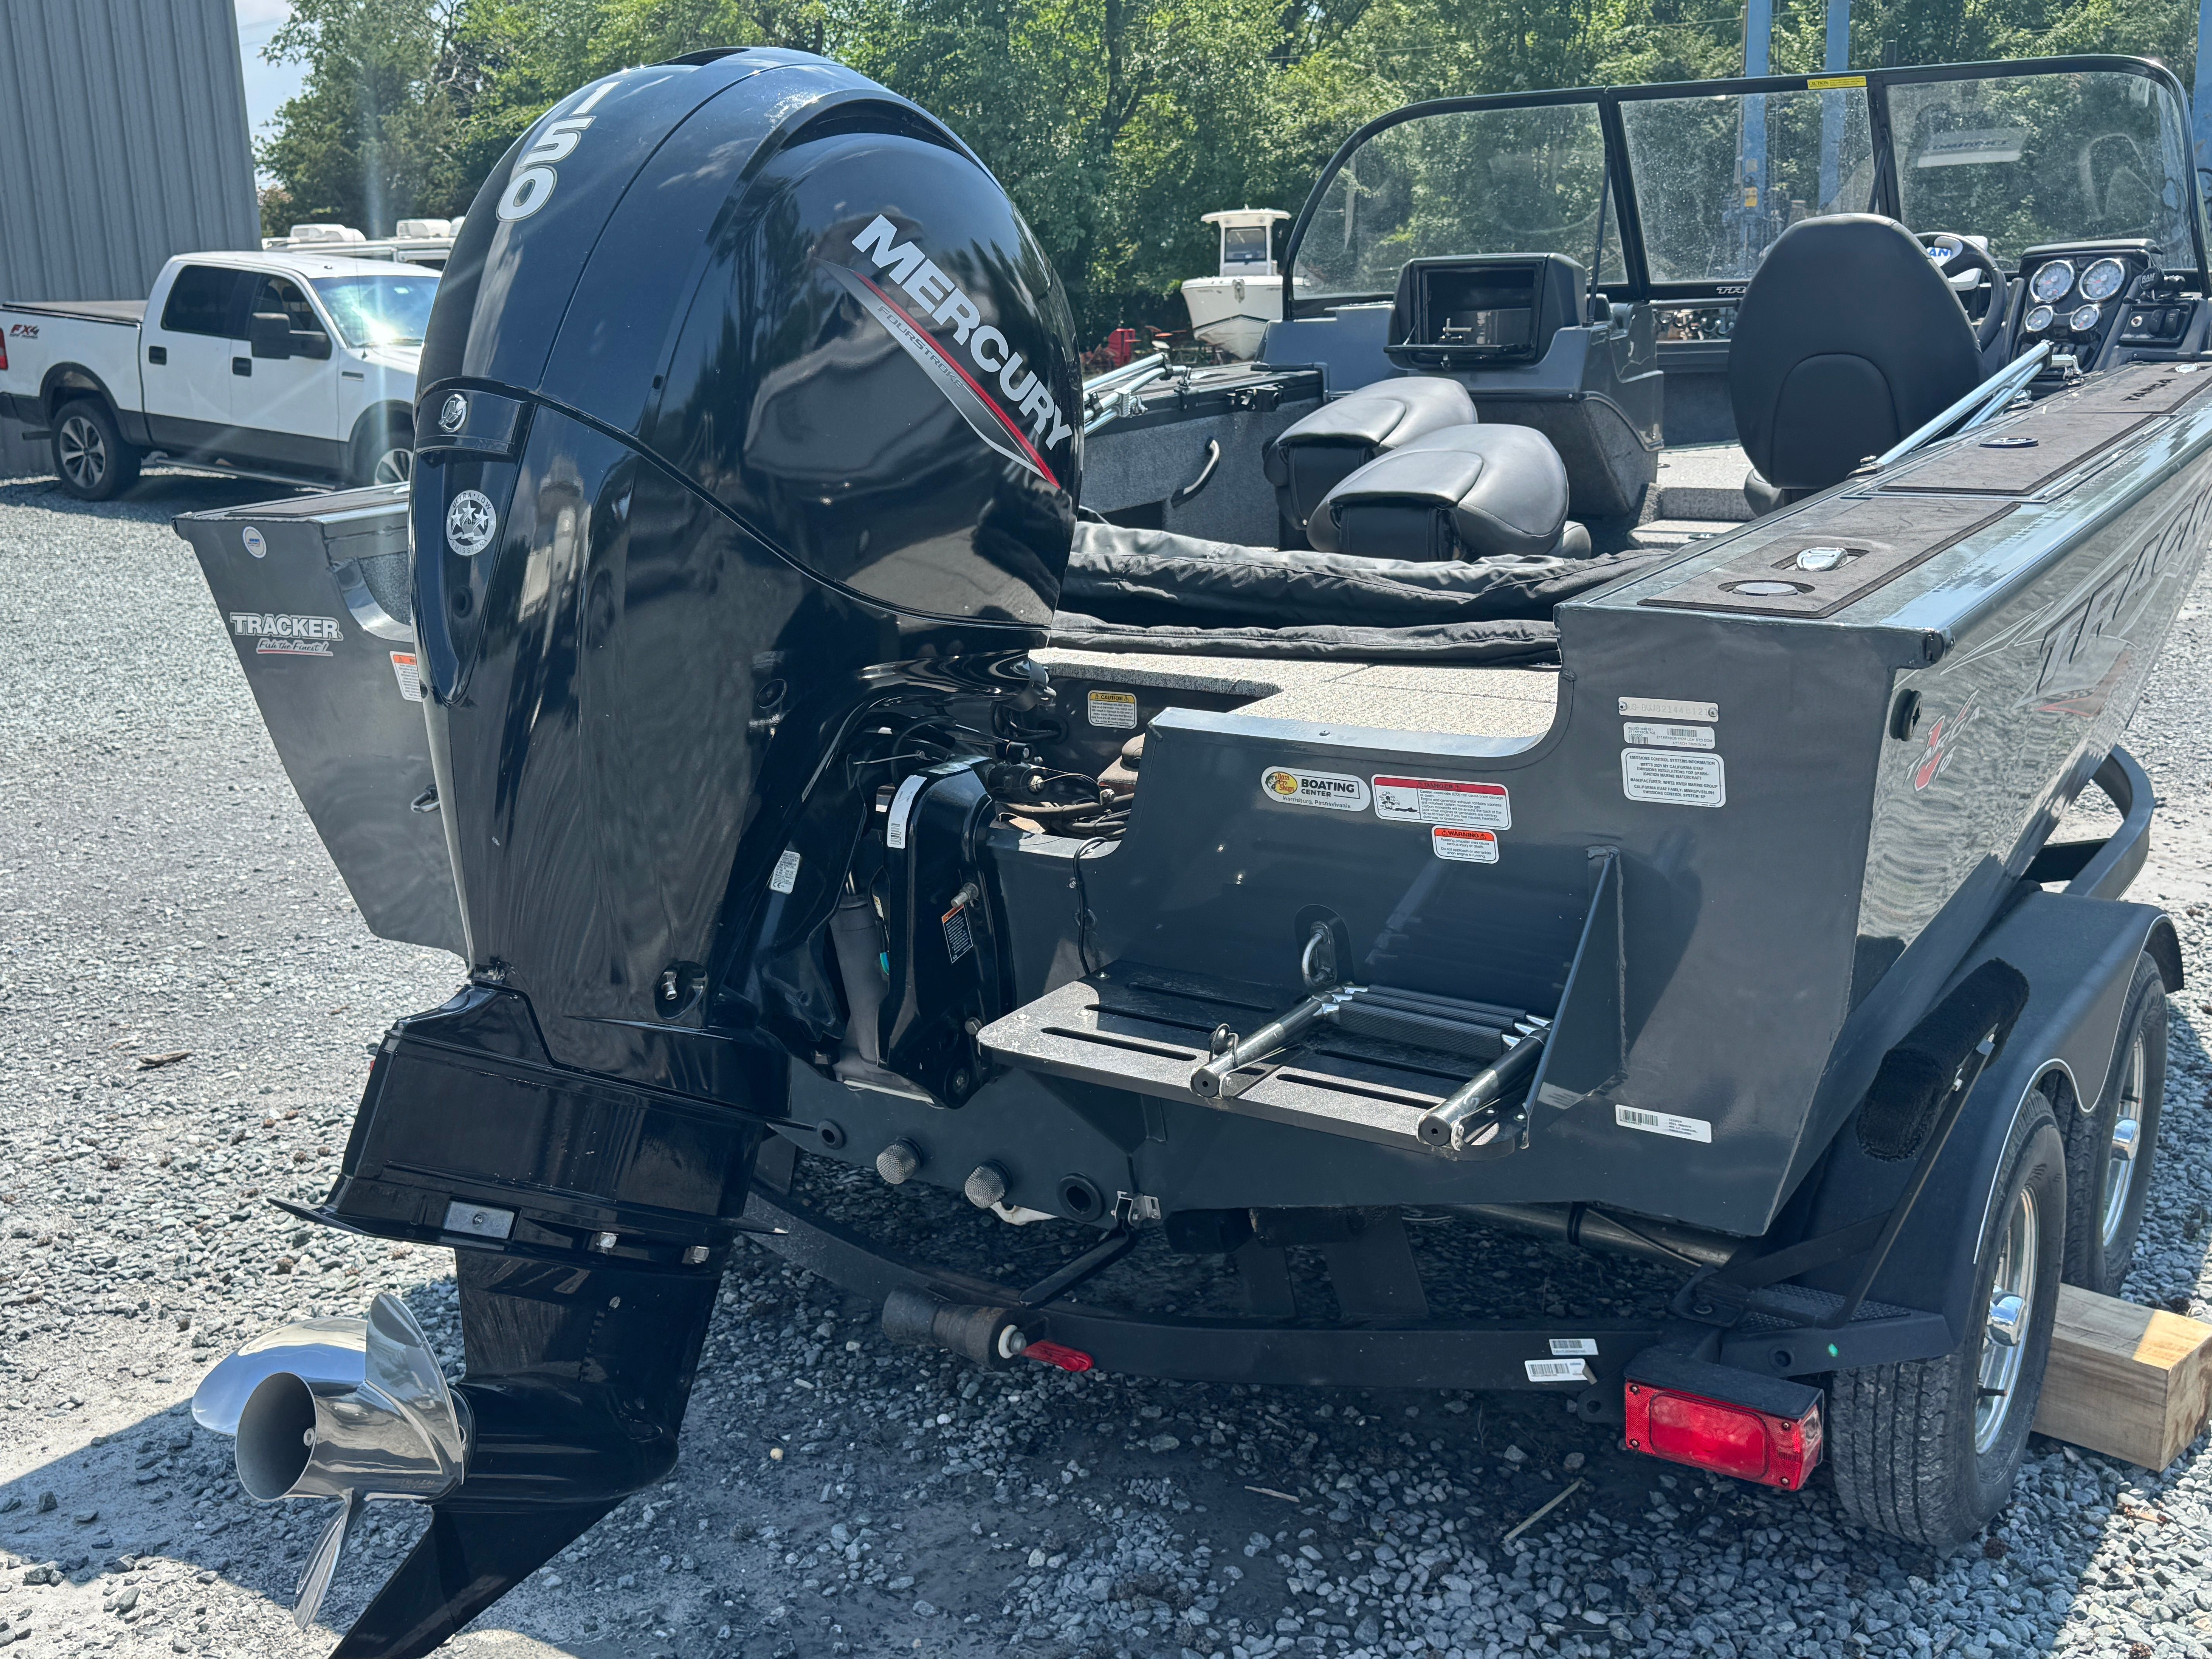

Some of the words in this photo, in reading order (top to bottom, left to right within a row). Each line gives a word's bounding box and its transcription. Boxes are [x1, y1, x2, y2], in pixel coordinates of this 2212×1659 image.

[496, 81, 622, 222] 150
[2142, 273, 2155, 284] RAM
[10, 324, 40, 335] FX4
[852, 214, 1072, 450] MERCURY
[878, 304, 963, 388] FOURSTROKE
[2119, 378, 2178, 401] TARGA
[477, 494, 491, 510] LOW
[231, 614, 340, 640] TRACKER
[259, 640, 276, 648] Fish
[278, 641, 291, 649] the
[1279, 785, 1294, 793] Shops
[1301, 779, 1354, 793] BOATING
[1301, 789, 1331, 797] CENTER
[1283, 796, 1313, 805] Harrisburg,
[1315, 800, 1351, 809] Pennsylvania
